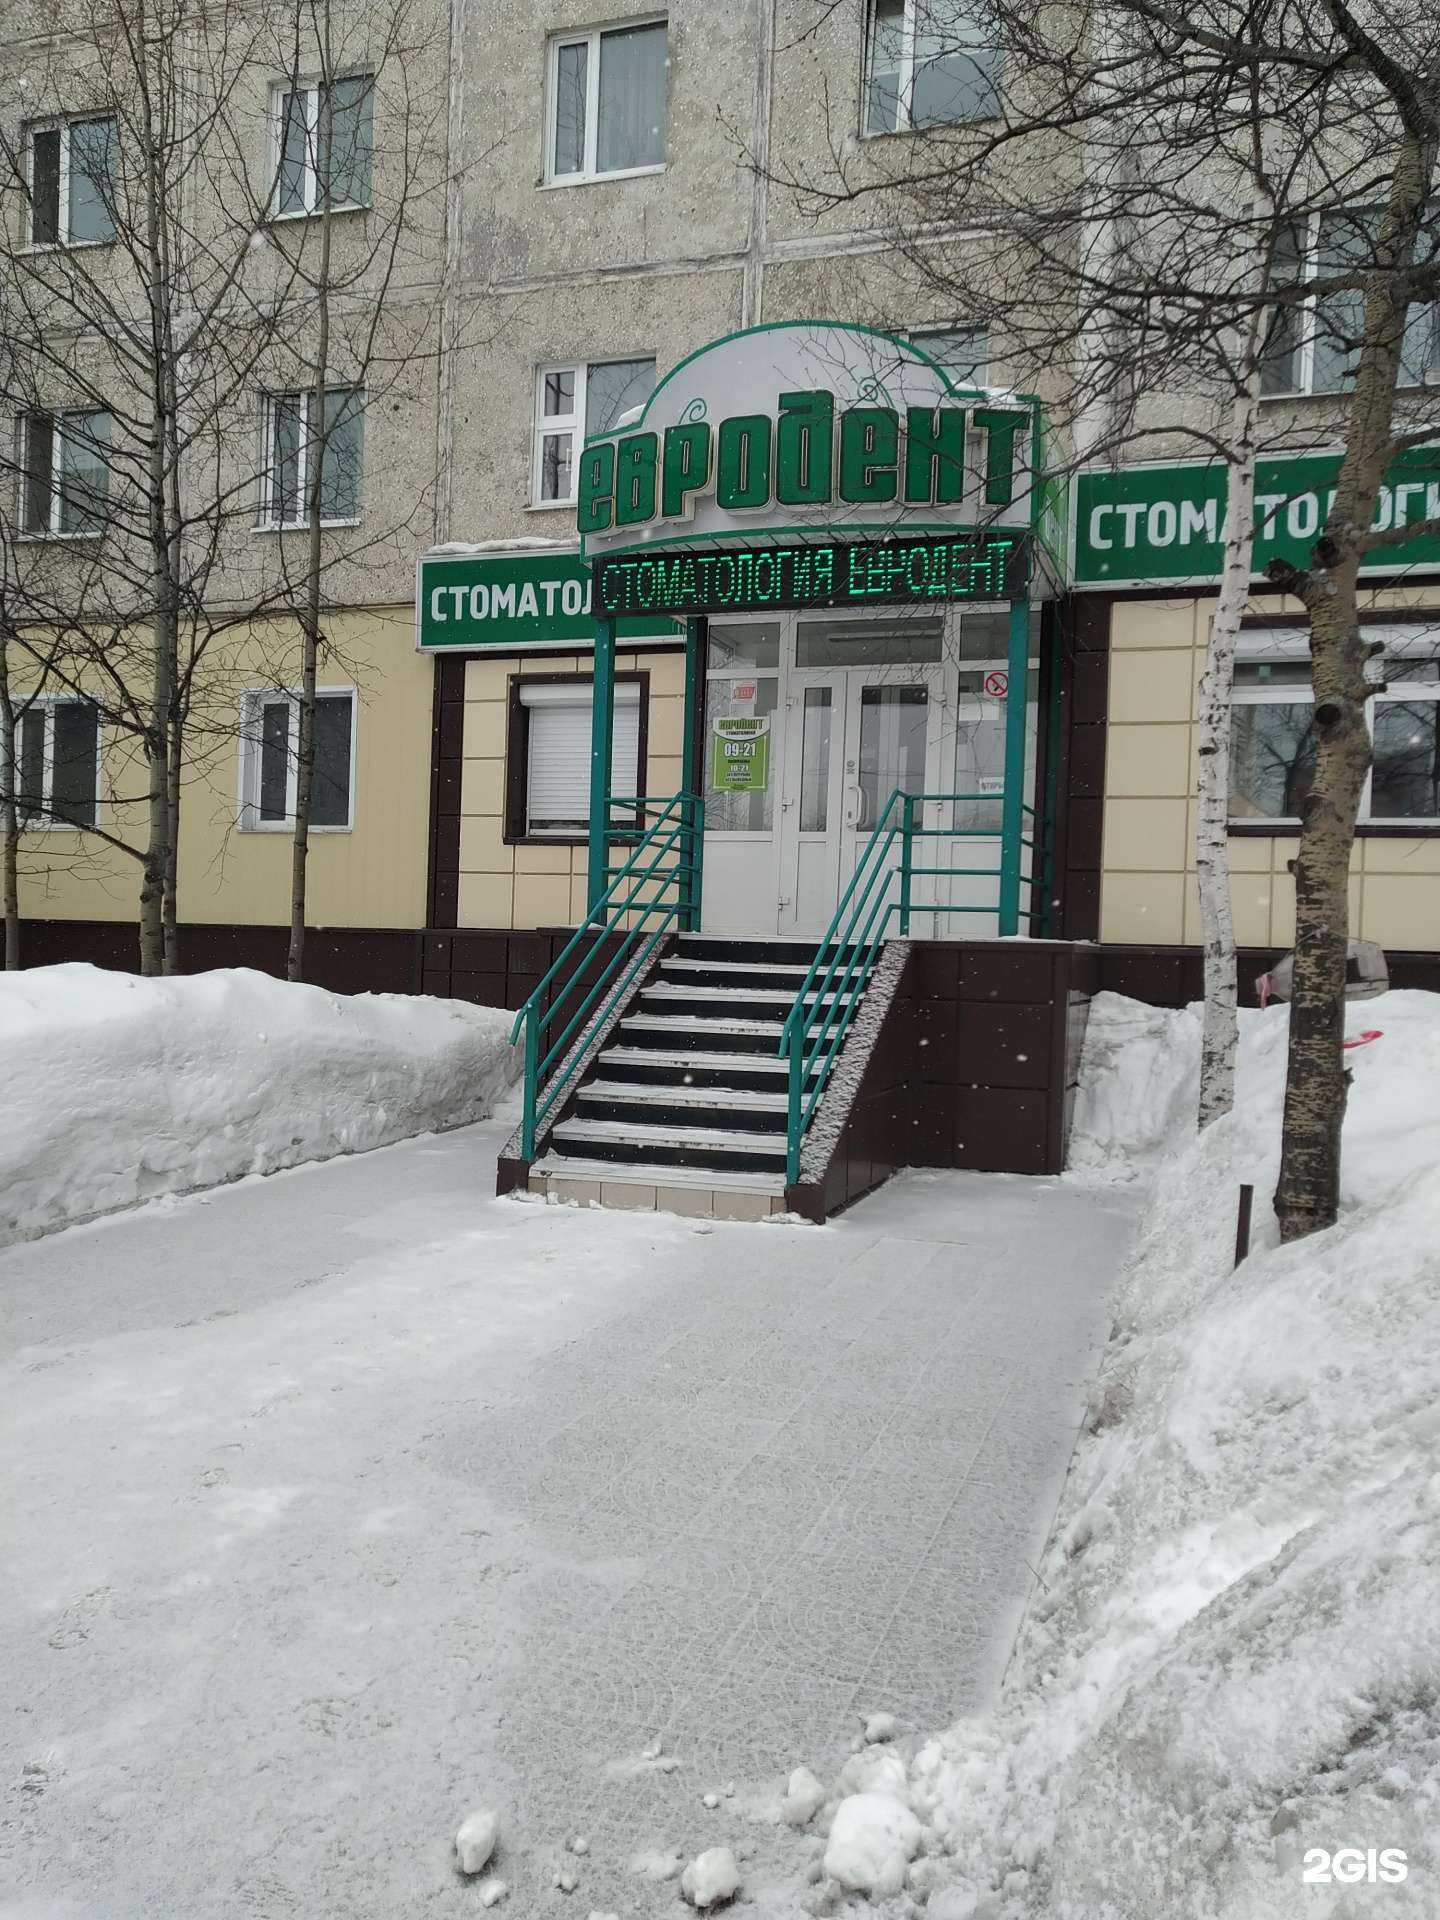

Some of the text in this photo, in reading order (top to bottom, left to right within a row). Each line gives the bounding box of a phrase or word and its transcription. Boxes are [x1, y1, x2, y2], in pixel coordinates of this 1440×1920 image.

[1089, 481, 1440, 549] СТОМТООГ
[602, 549, 833, 609] СТОМАТОЛОГИЯ
[724, 742, 757, 757] 09-21
